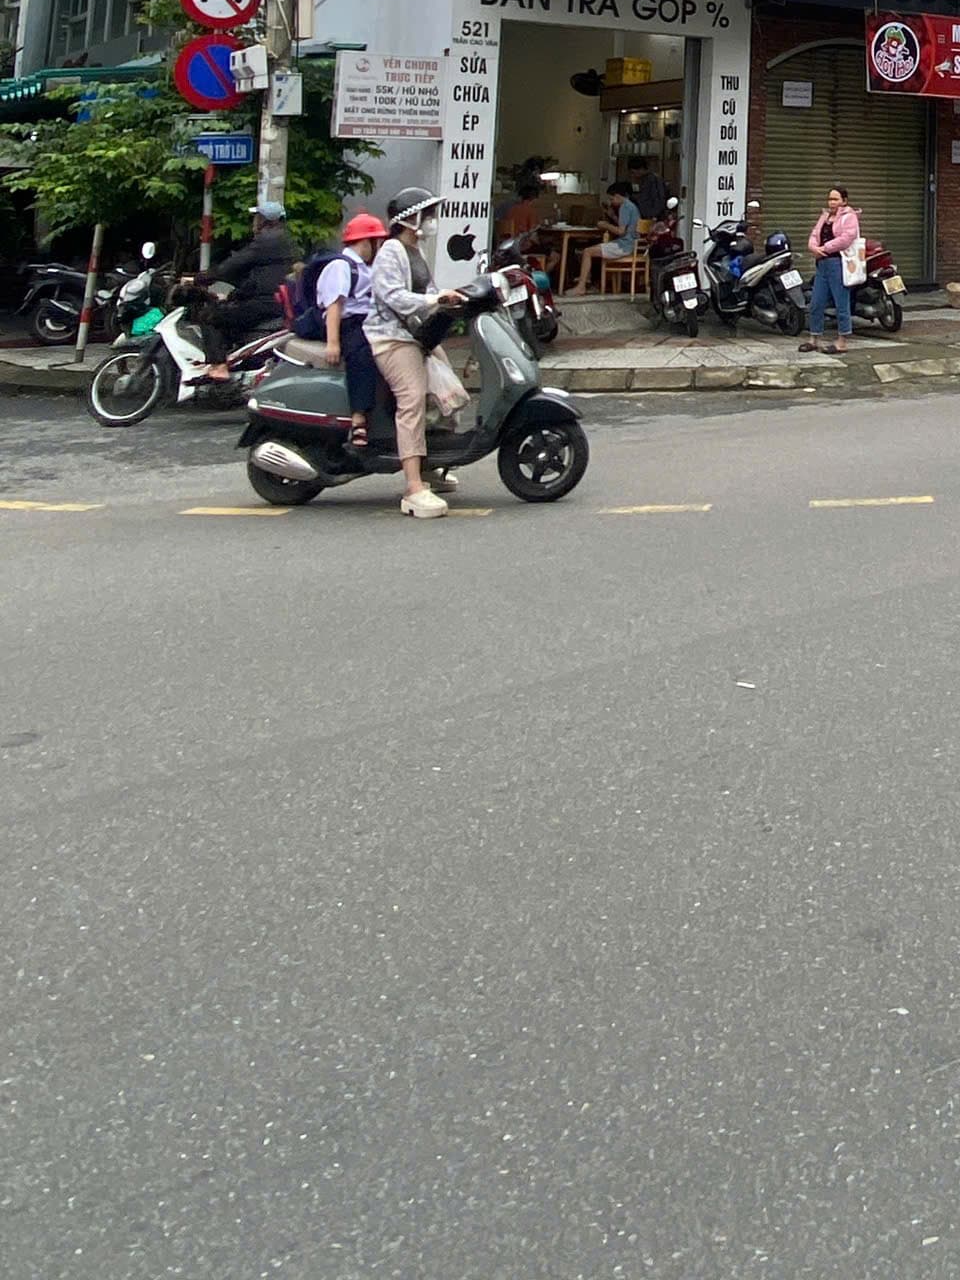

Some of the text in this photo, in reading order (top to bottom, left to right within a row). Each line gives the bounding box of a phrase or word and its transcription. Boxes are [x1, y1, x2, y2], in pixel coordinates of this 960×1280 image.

[706, 1, 729, 28] %
[461, 21, 489, 38] 521
[460, 51, 487, 75] SỬA
[376, 85, 393, 94] 55K
[453, 82, 490, 104] CHỮA
[720, 76, 739, 91] THU
[374, 96, 396, 105] 100K
[421, 97, 440, 107] LỚN
[722, 98, 736, 115] CŨ
[462, 111, 479, 131] ÉP
[720, 121, 737, 140] ĐỔI
[451, 140, 485, 161] KÍNH
[718, 147, 737, 166] MỚI
[454, 165, 479, 189] LẤY
[718, 172, 735, 191] GIÁ
[441, 201, 489, 219] NHANH
[717, 198, 734, 217] TỐT
